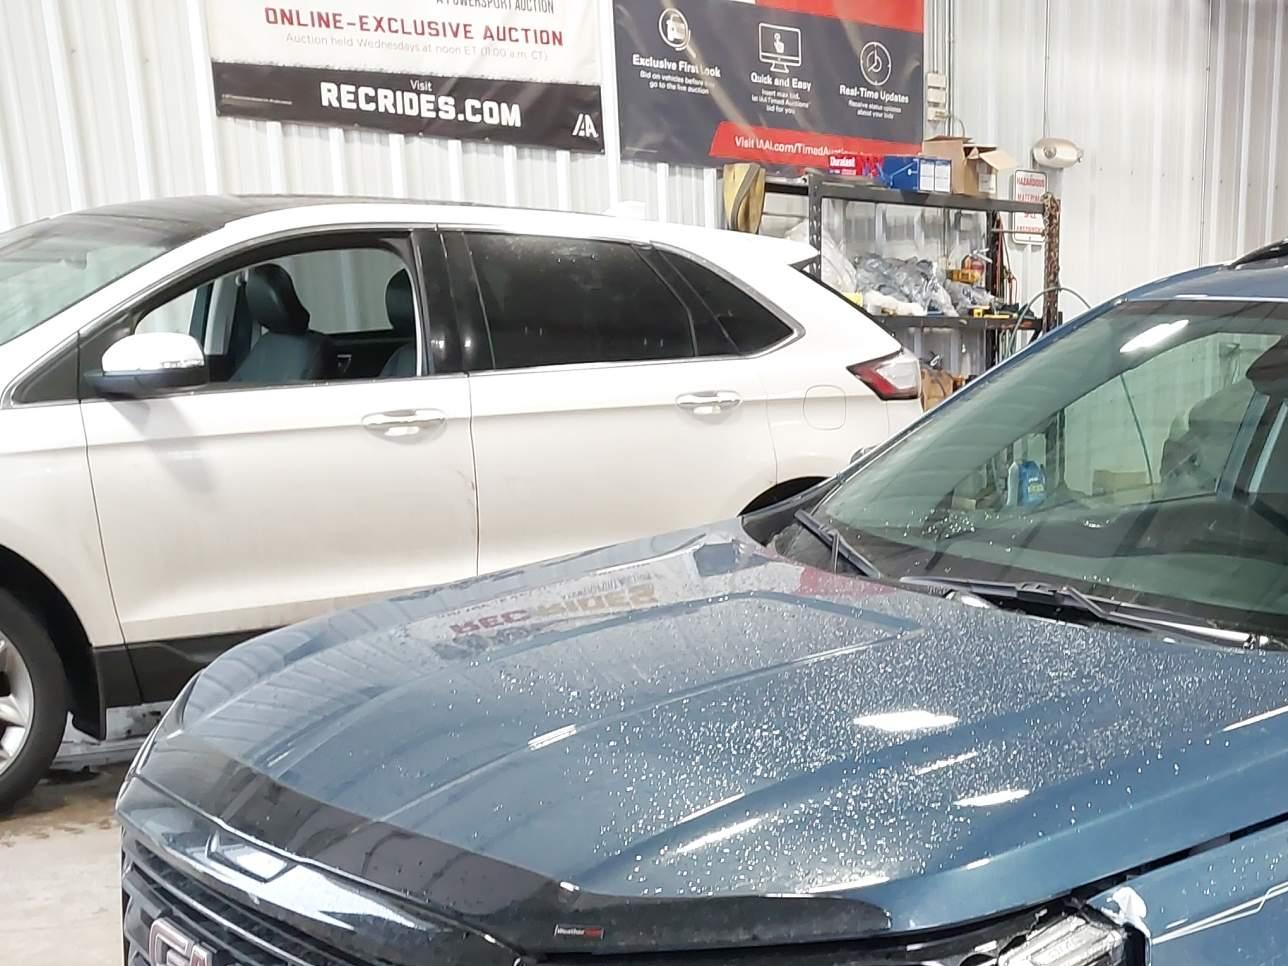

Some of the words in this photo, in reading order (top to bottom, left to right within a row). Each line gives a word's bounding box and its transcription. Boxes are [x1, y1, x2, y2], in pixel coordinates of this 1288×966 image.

[513, 0, 554, 14] AUCTION
[264, 7, 475, 40] ONLINE-EXCLUSIVE
[483, 24, 564, 46] AUCTION
[286, 32, 328, 46] Auction
[331, 36, 354, 48] held
[356, 38, 421, 53] Wednesdays
[422, 43, 432, 53] at
[435, 45, 462, 55] noon
[464, 45, 478, 56] ET
[632, 53, 677, 70] Exclusive
[678, 60, 700, 74] First
[700, 63, 721, 77] Look
[409, 79, 433, 92] Visit
[639, 70, 652, 79] Bid
[661, 73, 684, 84] vehicles
[684, 76, 704, 86] before
[750, 72, 773, 85] Quick
[773, 77, 790, 87] and
[791, 77, 812, 92] Easy
[649, 81, 659, 89] go
[658, 81, 666, 89] to
[666, 82, 677, 91] the
[687, 85, 710, 95] auction
[839, 84, 879, 99] Real-Time
[879, 89, 909, 103] Updates
[319, 81, 522, 128] RECRIDES.COM
[775, 105, 785, 113] for
[784, 107, 796, 115] you
[848, 99, 868, 109] Receive
[857, 108, 872, 117] about
[872, 111, 884, 119] your
[735, 135, 754, 149] Visit
[755, 138, 857, 157] IAAI.com/TimedAu
